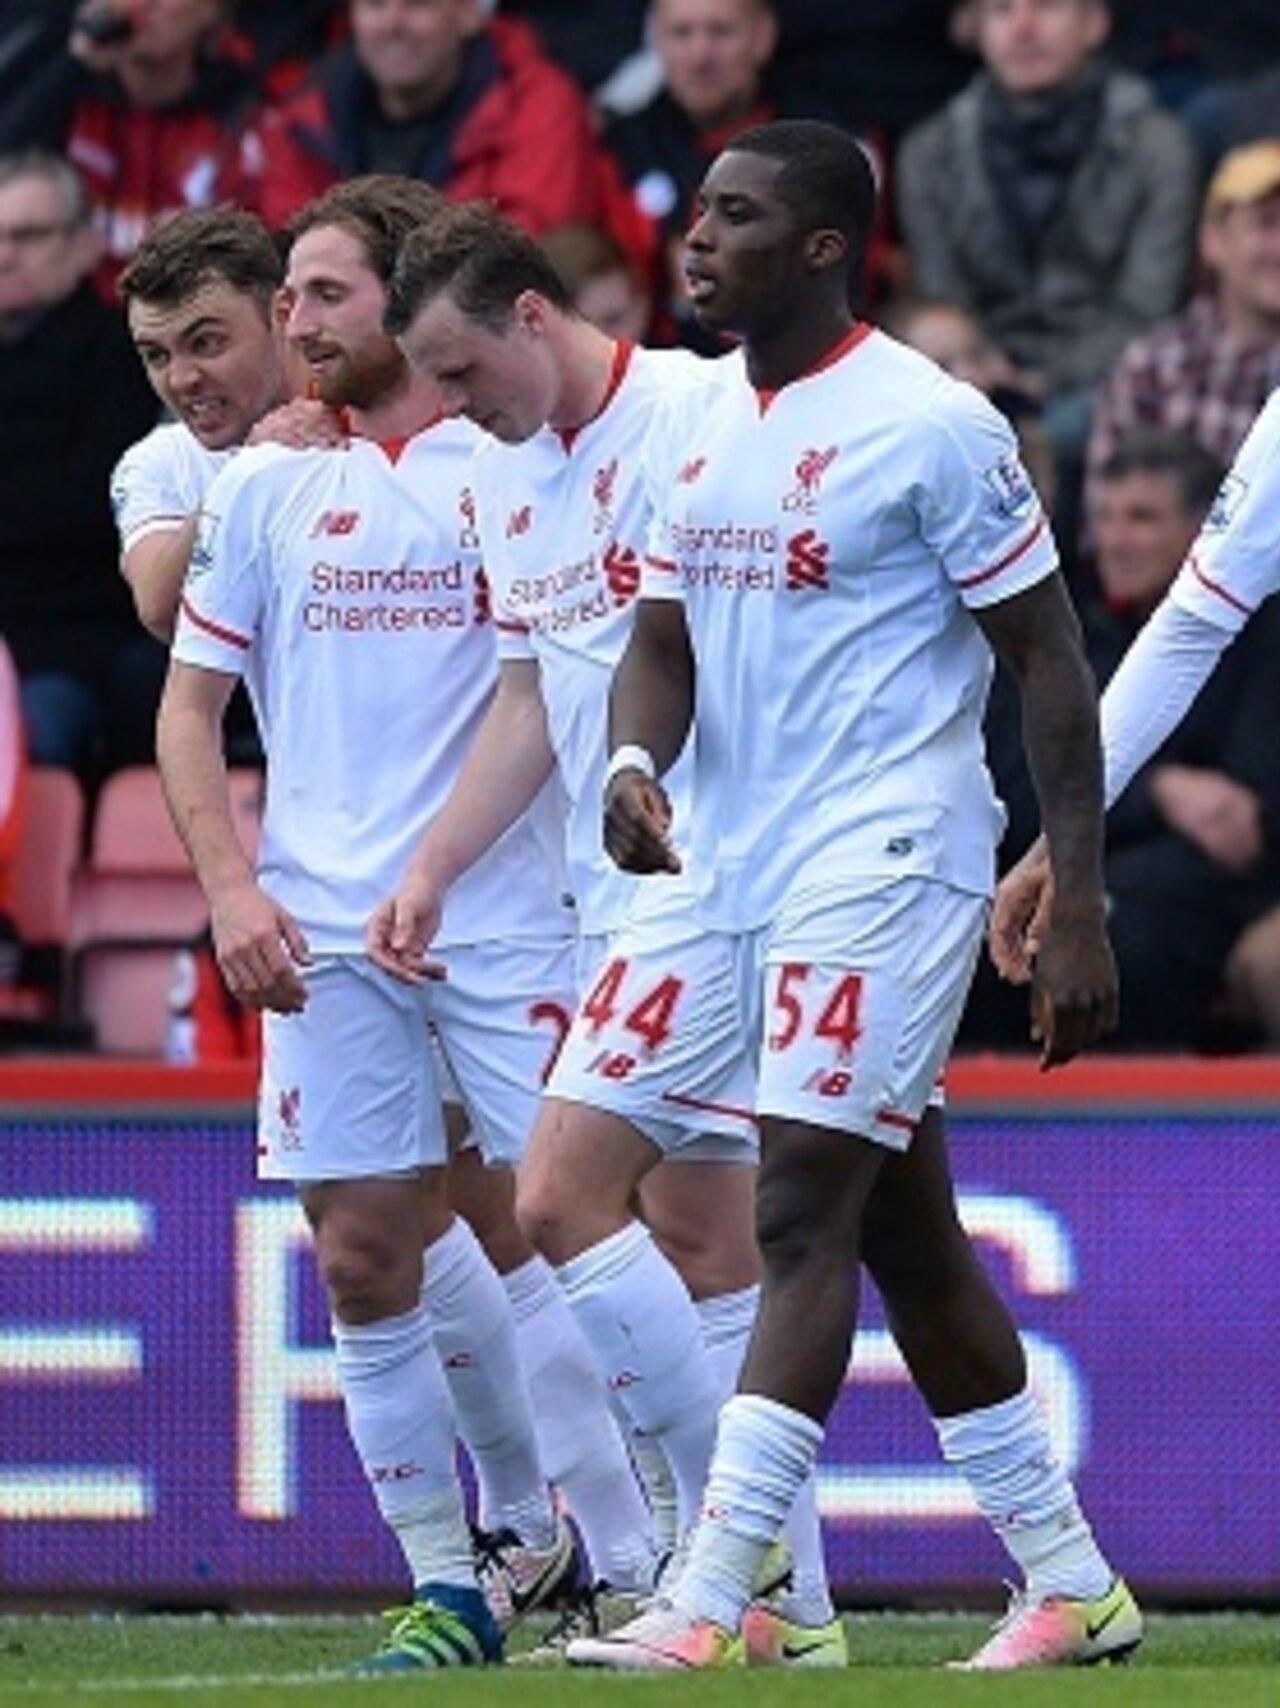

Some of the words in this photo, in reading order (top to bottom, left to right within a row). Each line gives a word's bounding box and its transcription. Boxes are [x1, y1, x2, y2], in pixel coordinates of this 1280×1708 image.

[310, 560, 464, 594] Standard
[302, 600, 467, 634] Chartered
[581, 956, 685, 1058] 44
[768, 960, 864, 1060] 54
